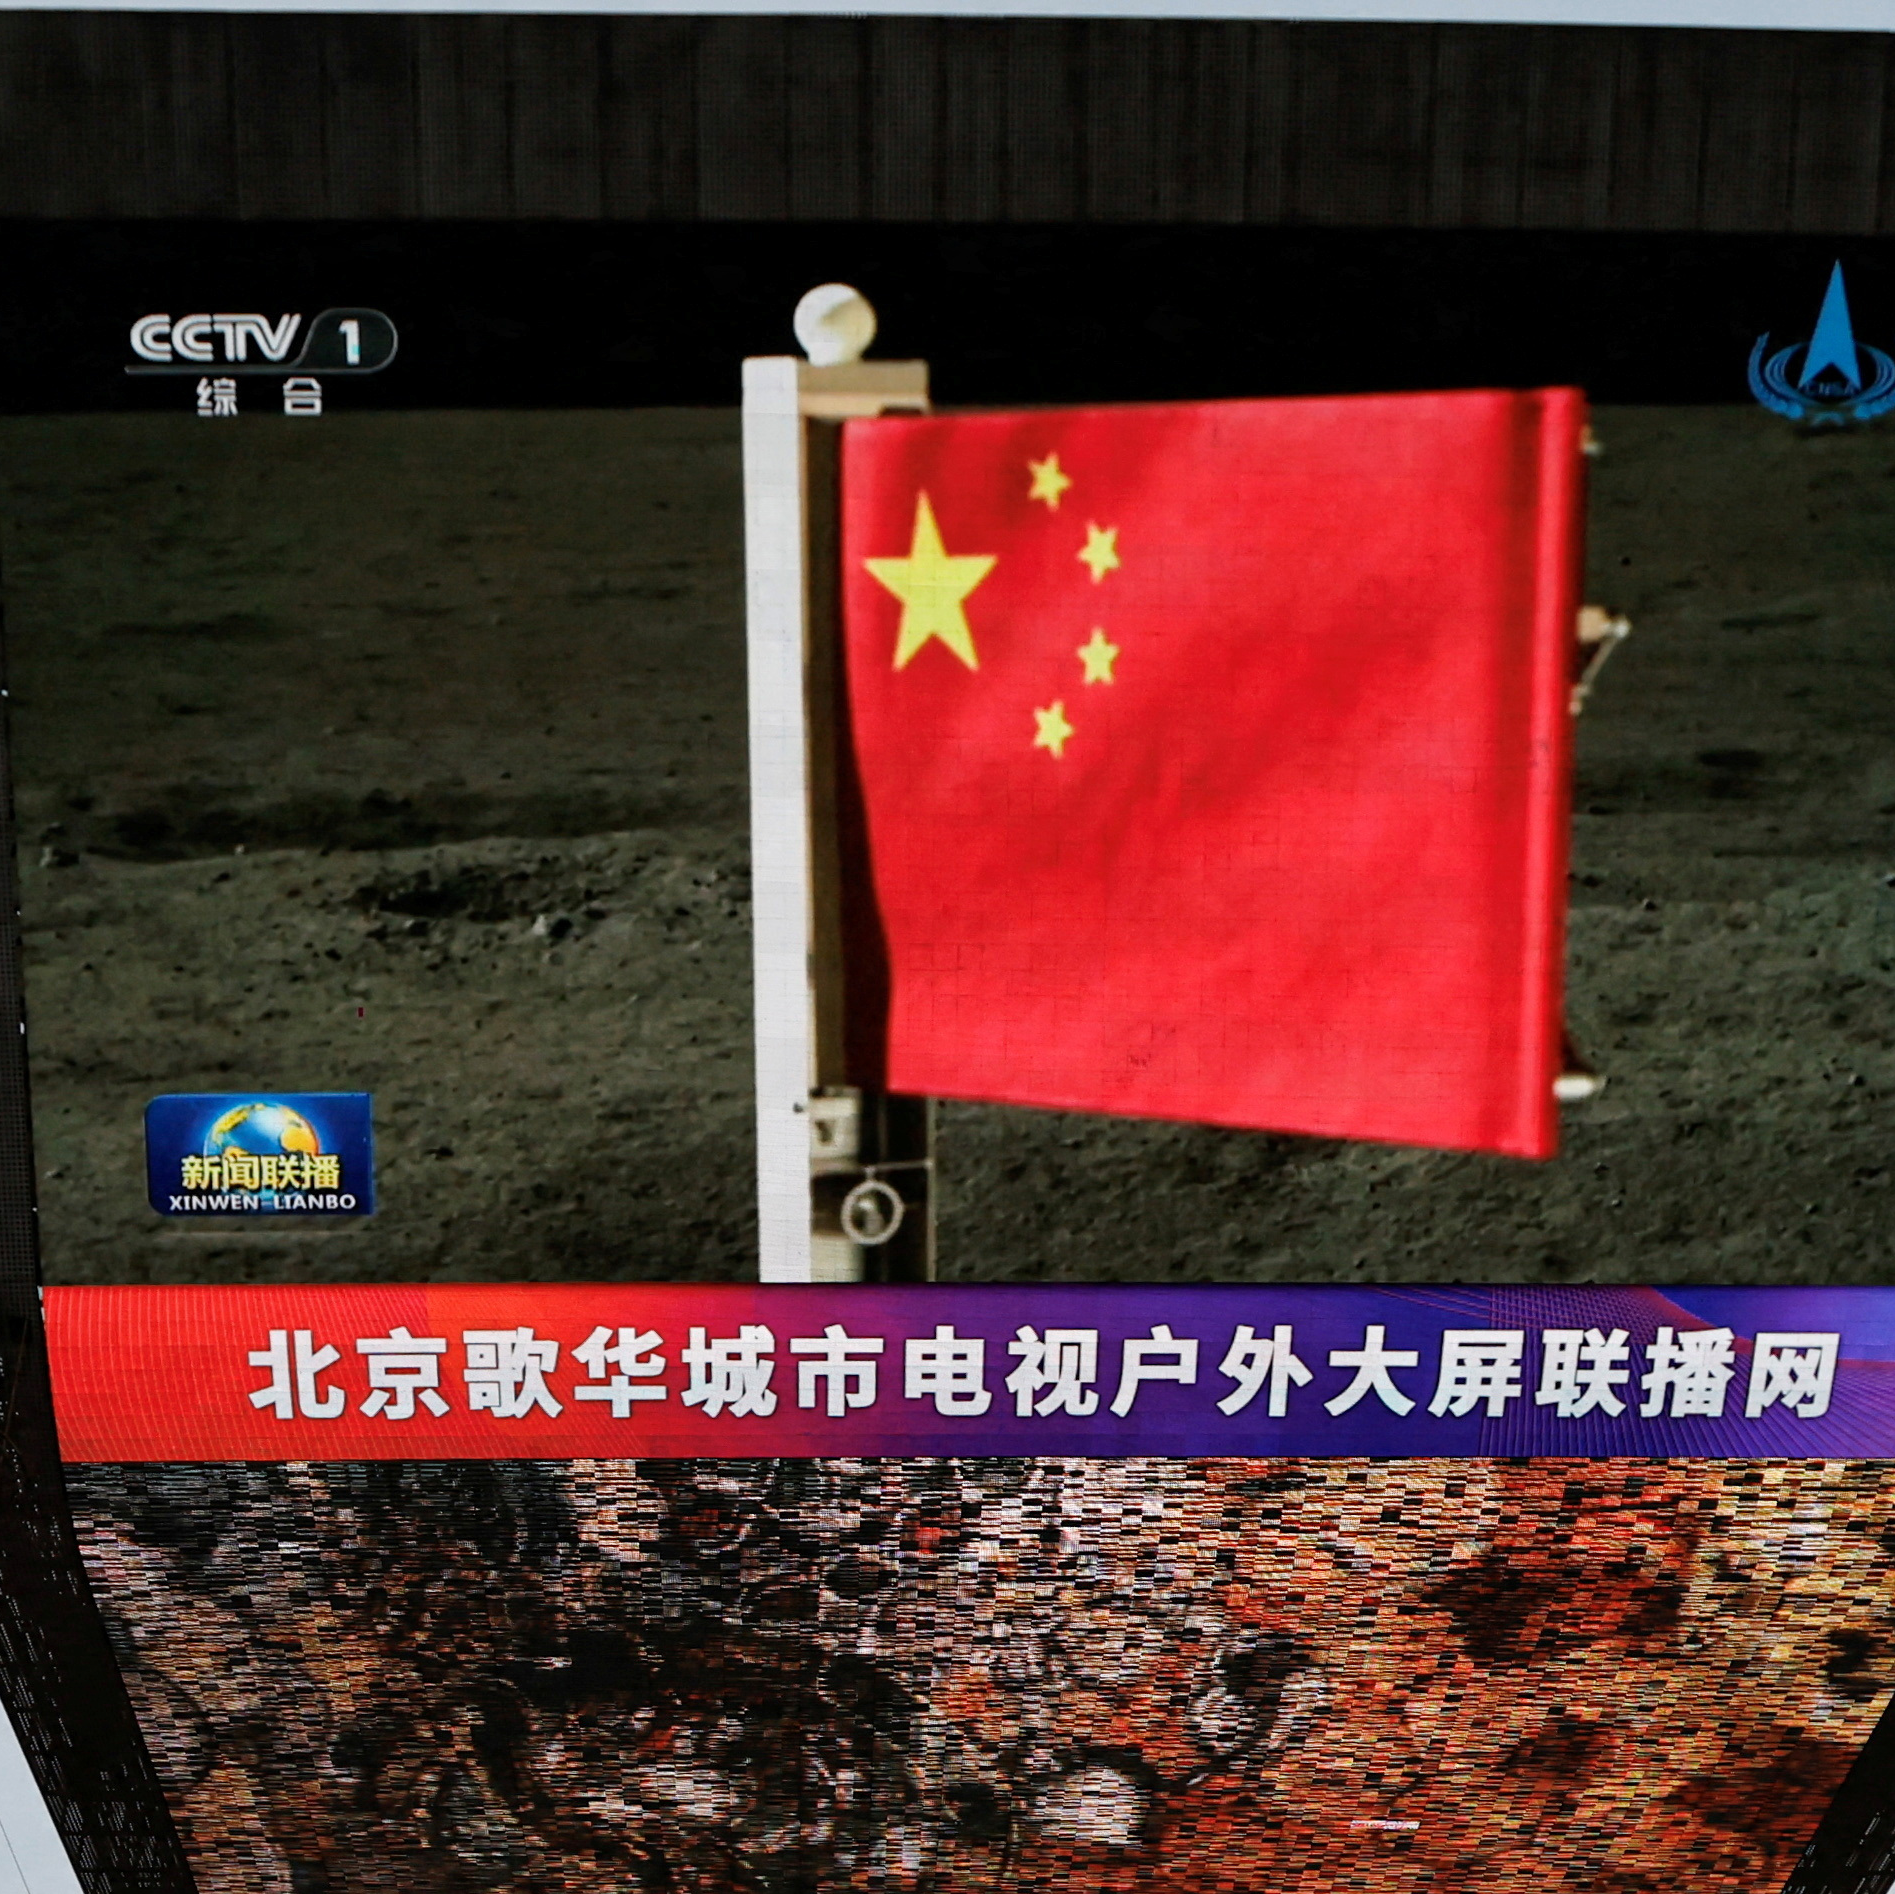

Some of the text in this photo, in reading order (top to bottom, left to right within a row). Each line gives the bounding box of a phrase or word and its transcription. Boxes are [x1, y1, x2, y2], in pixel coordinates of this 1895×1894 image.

[130, 313, 361, 365] CCTV 1
[196, 377, 322, 417] 综合
[181, 1154, 341, 1190] 新闻联播
[247, 1324, 1841, 1418] 北京歌华城市电视户外大屏联播网
